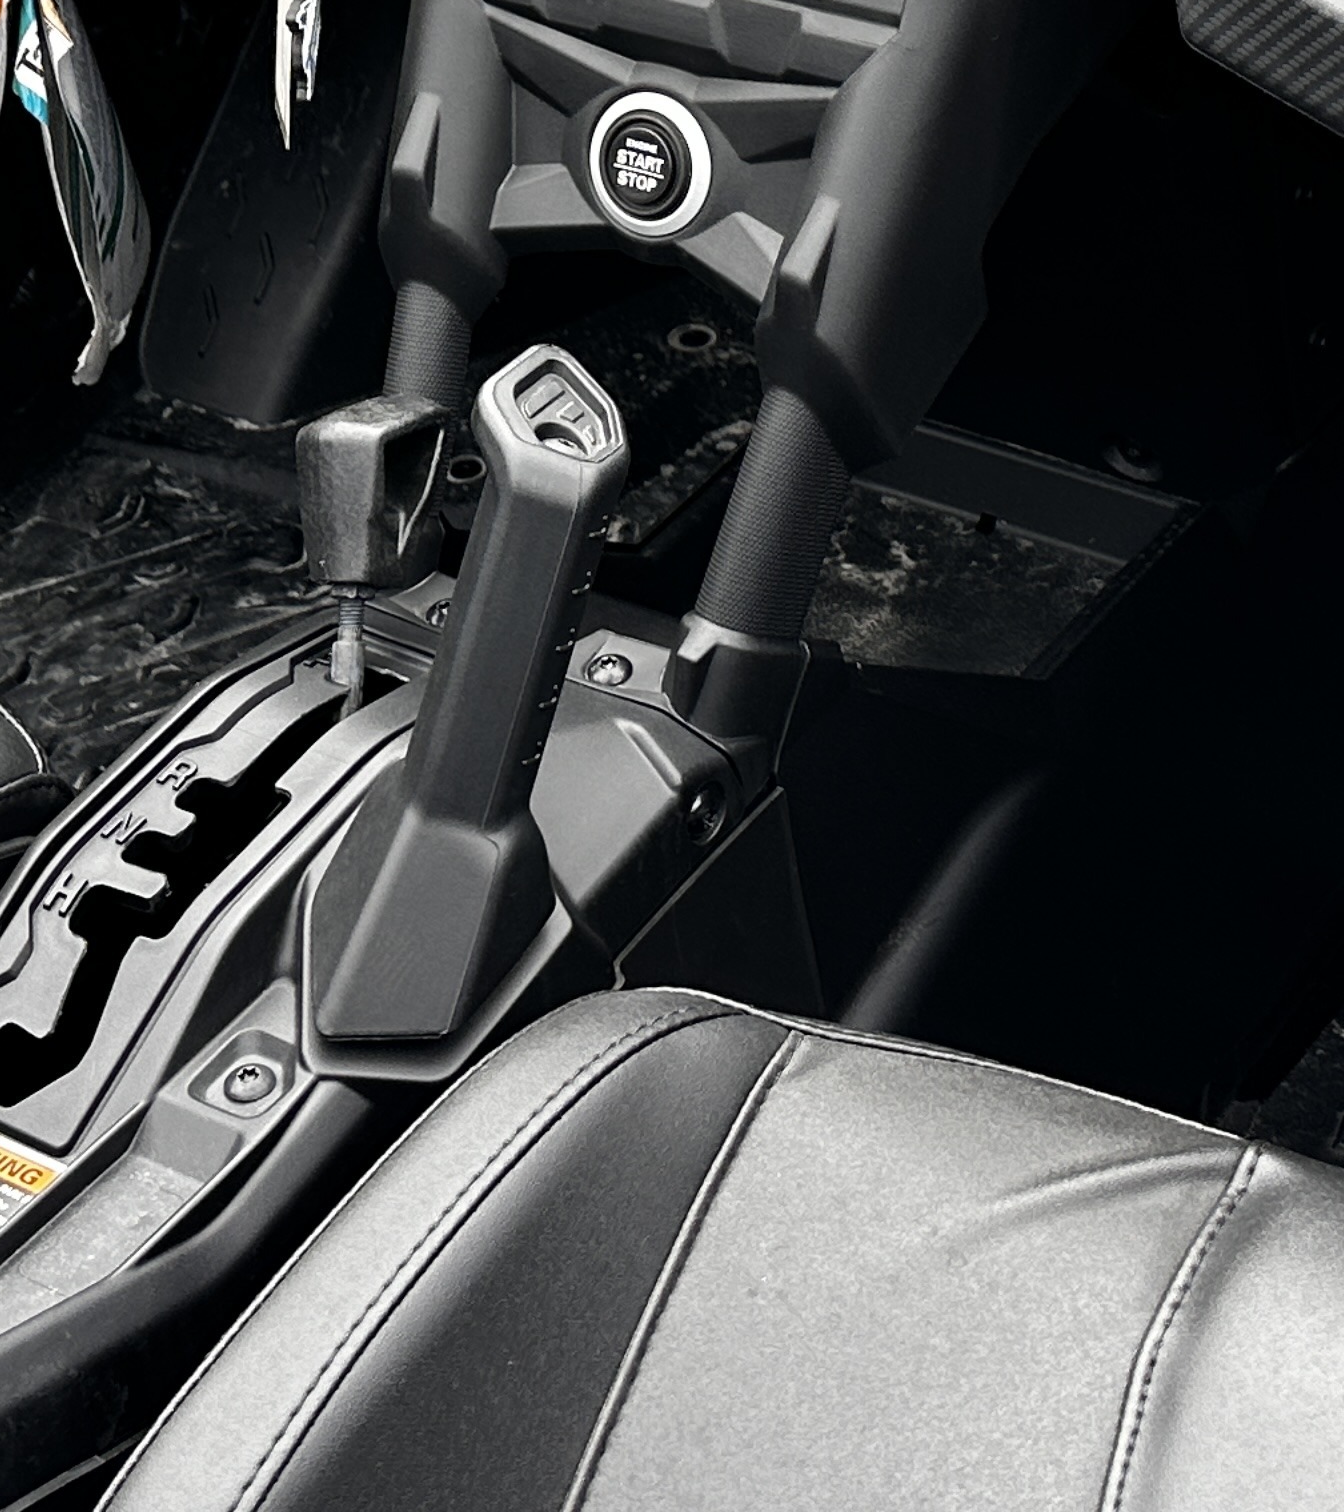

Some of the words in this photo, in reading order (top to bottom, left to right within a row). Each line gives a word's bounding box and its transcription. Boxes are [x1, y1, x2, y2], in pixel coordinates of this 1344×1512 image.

[616, 148, 665, 173] START
[617, 170, 657, 192] STOP
[156, 759, 198, 790] R
[100, 812, 147, 844] N
[43, 873, 89, 917] H
